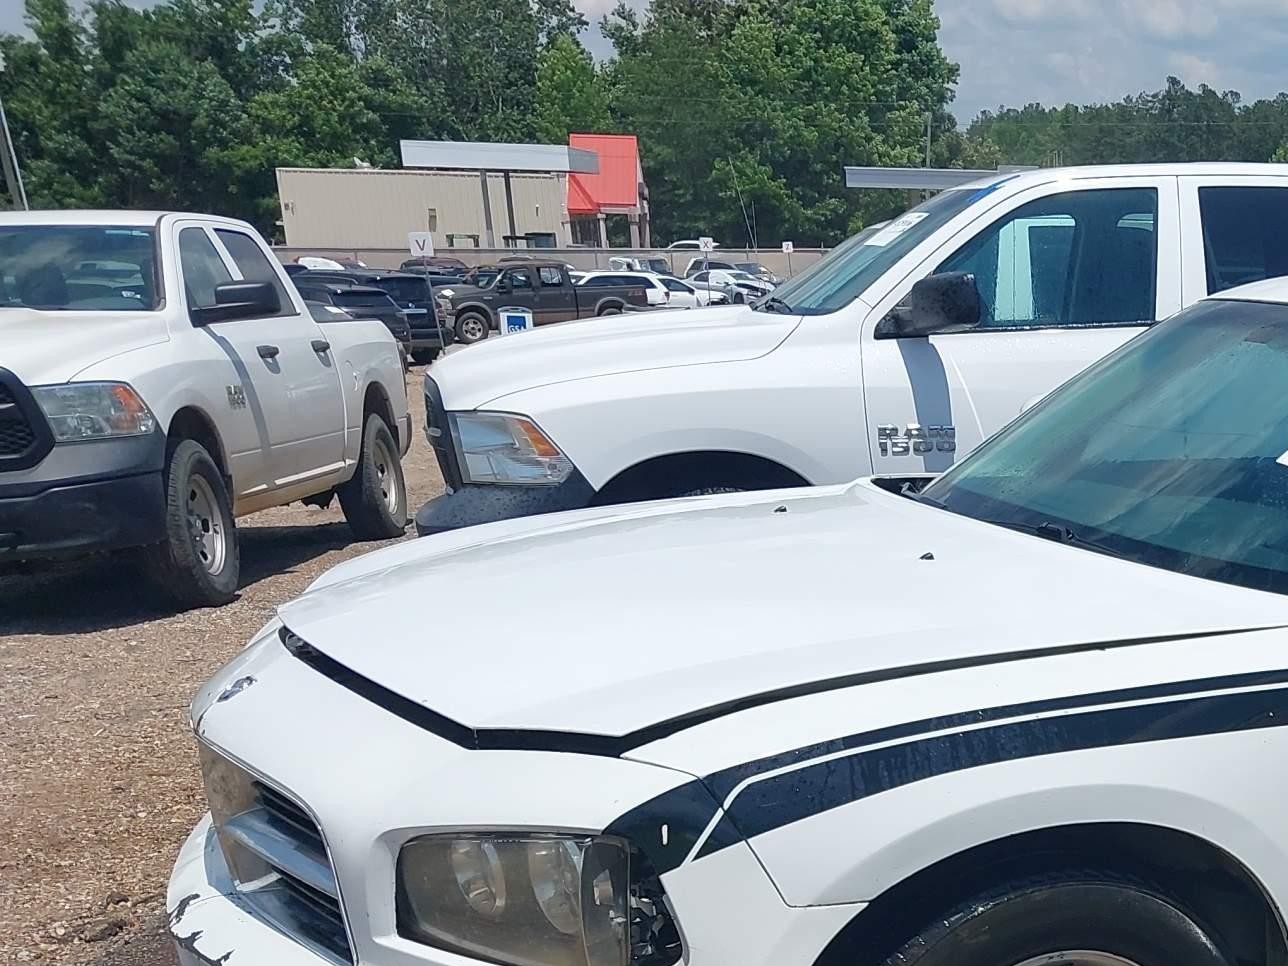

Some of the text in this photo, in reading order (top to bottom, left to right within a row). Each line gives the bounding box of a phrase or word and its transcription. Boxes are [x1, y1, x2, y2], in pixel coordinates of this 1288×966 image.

[415, 239, 427, 251] V
[703, 240, 709, 249] X
[877, 424, 956, 440] RAM
[879, 440, 957, 456] 1500
